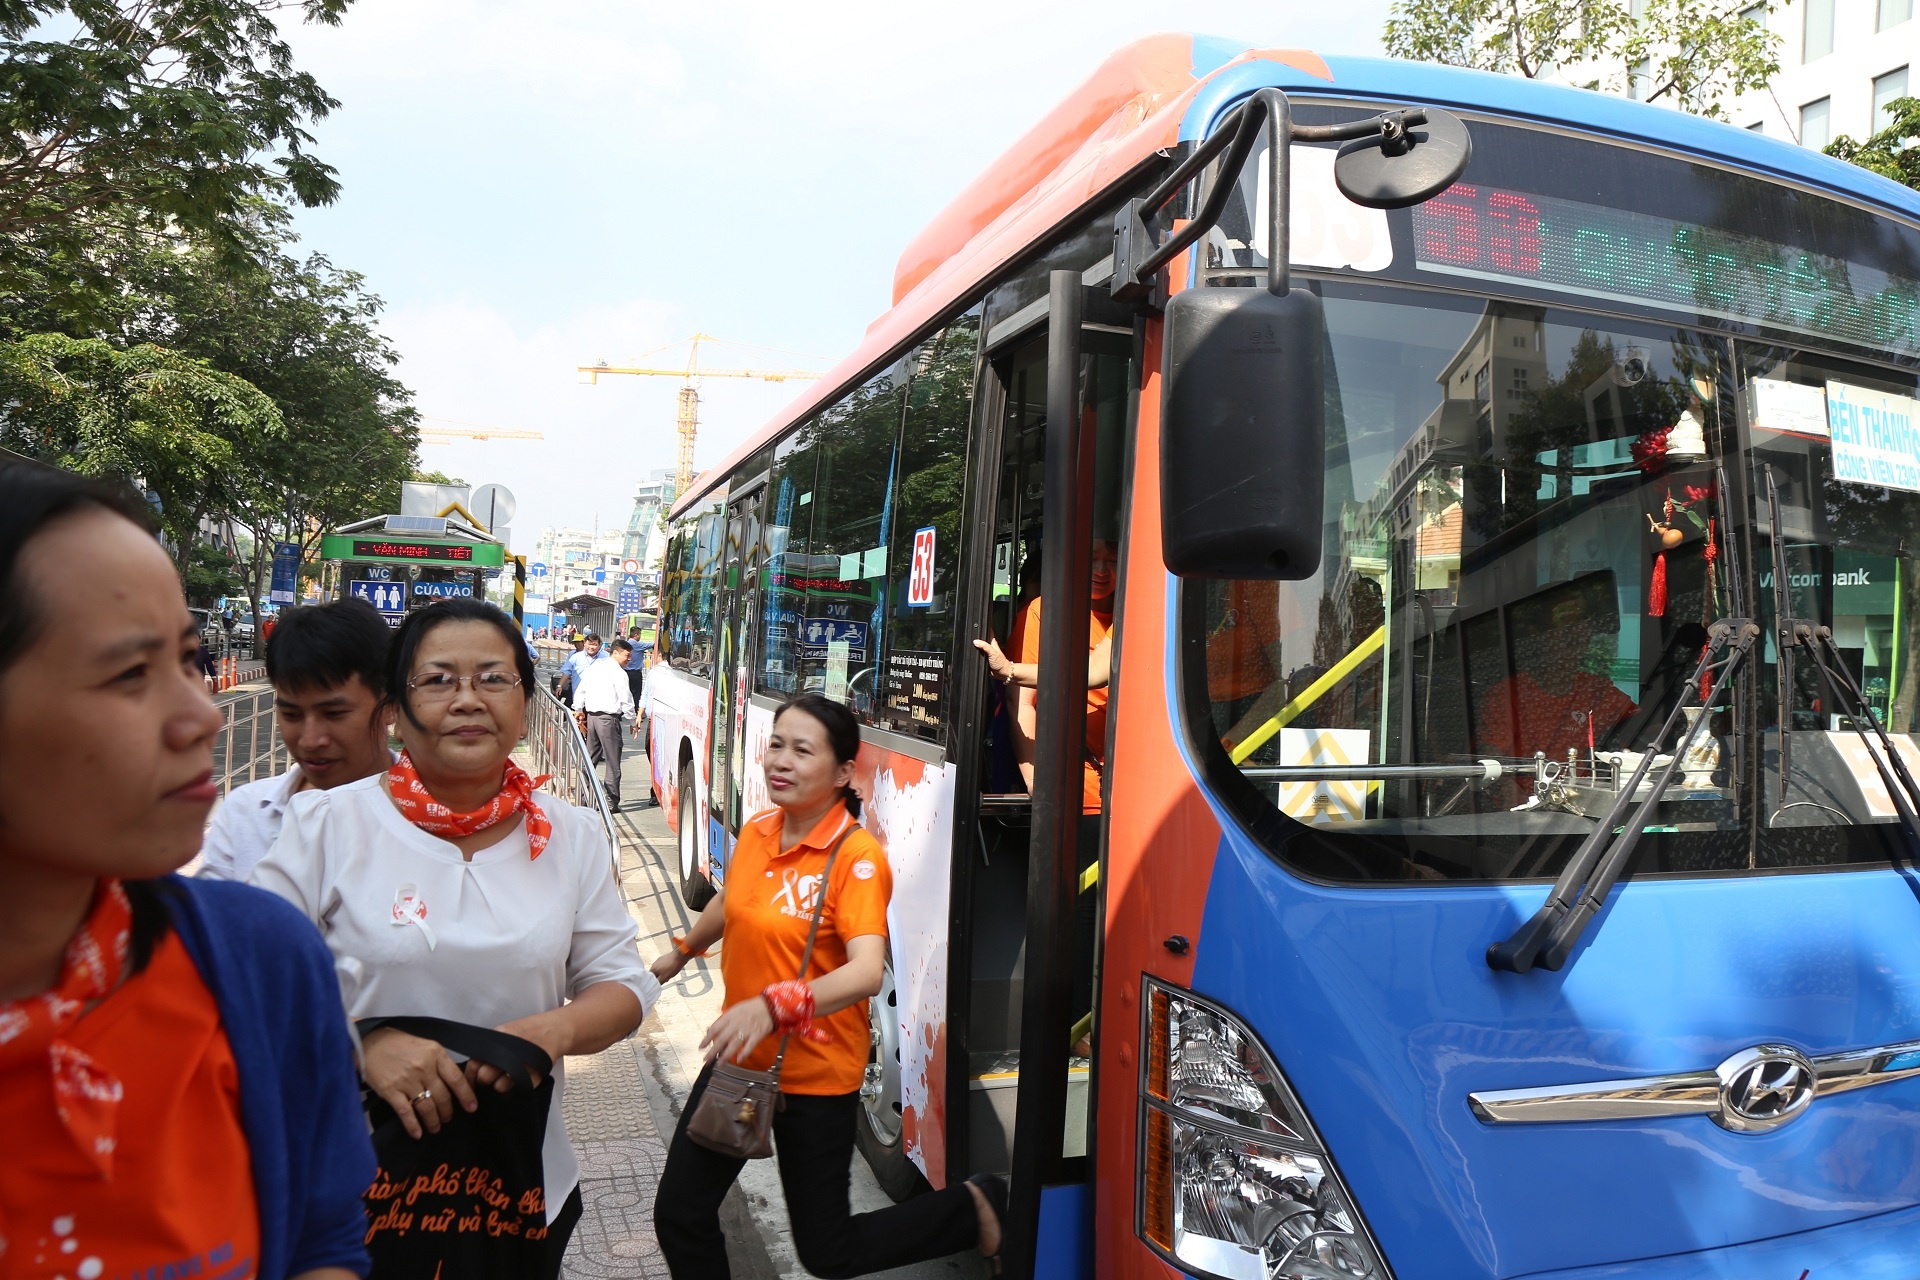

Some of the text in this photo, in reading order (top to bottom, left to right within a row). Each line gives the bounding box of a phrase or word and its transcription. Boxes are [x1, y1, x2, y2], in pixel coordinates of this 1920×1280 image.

[1424, 184, 1540, 273] 53
[1829, 386, 1861, 445] BẾN
[1862, 398, 1913, 455] THÀNH
[1836, 448, 1868, 480] CÔNG
[1868, 455, 1896, 484] VIÊN
[368, 567, 390, 579] WC
[414, 581, 471, 597] CỬA VÀO
[912, 532, 933, 602] 53
[406, 1163, 466, 1206] phố
[465, 1167, 511, 1210] thân
[364, 1199, 414, 1245] phụ
[420, 1208, 456, 1232] nữ
[458, 1204, 482, 1233] và
[486, 1210, 523, 1237] trẻ
